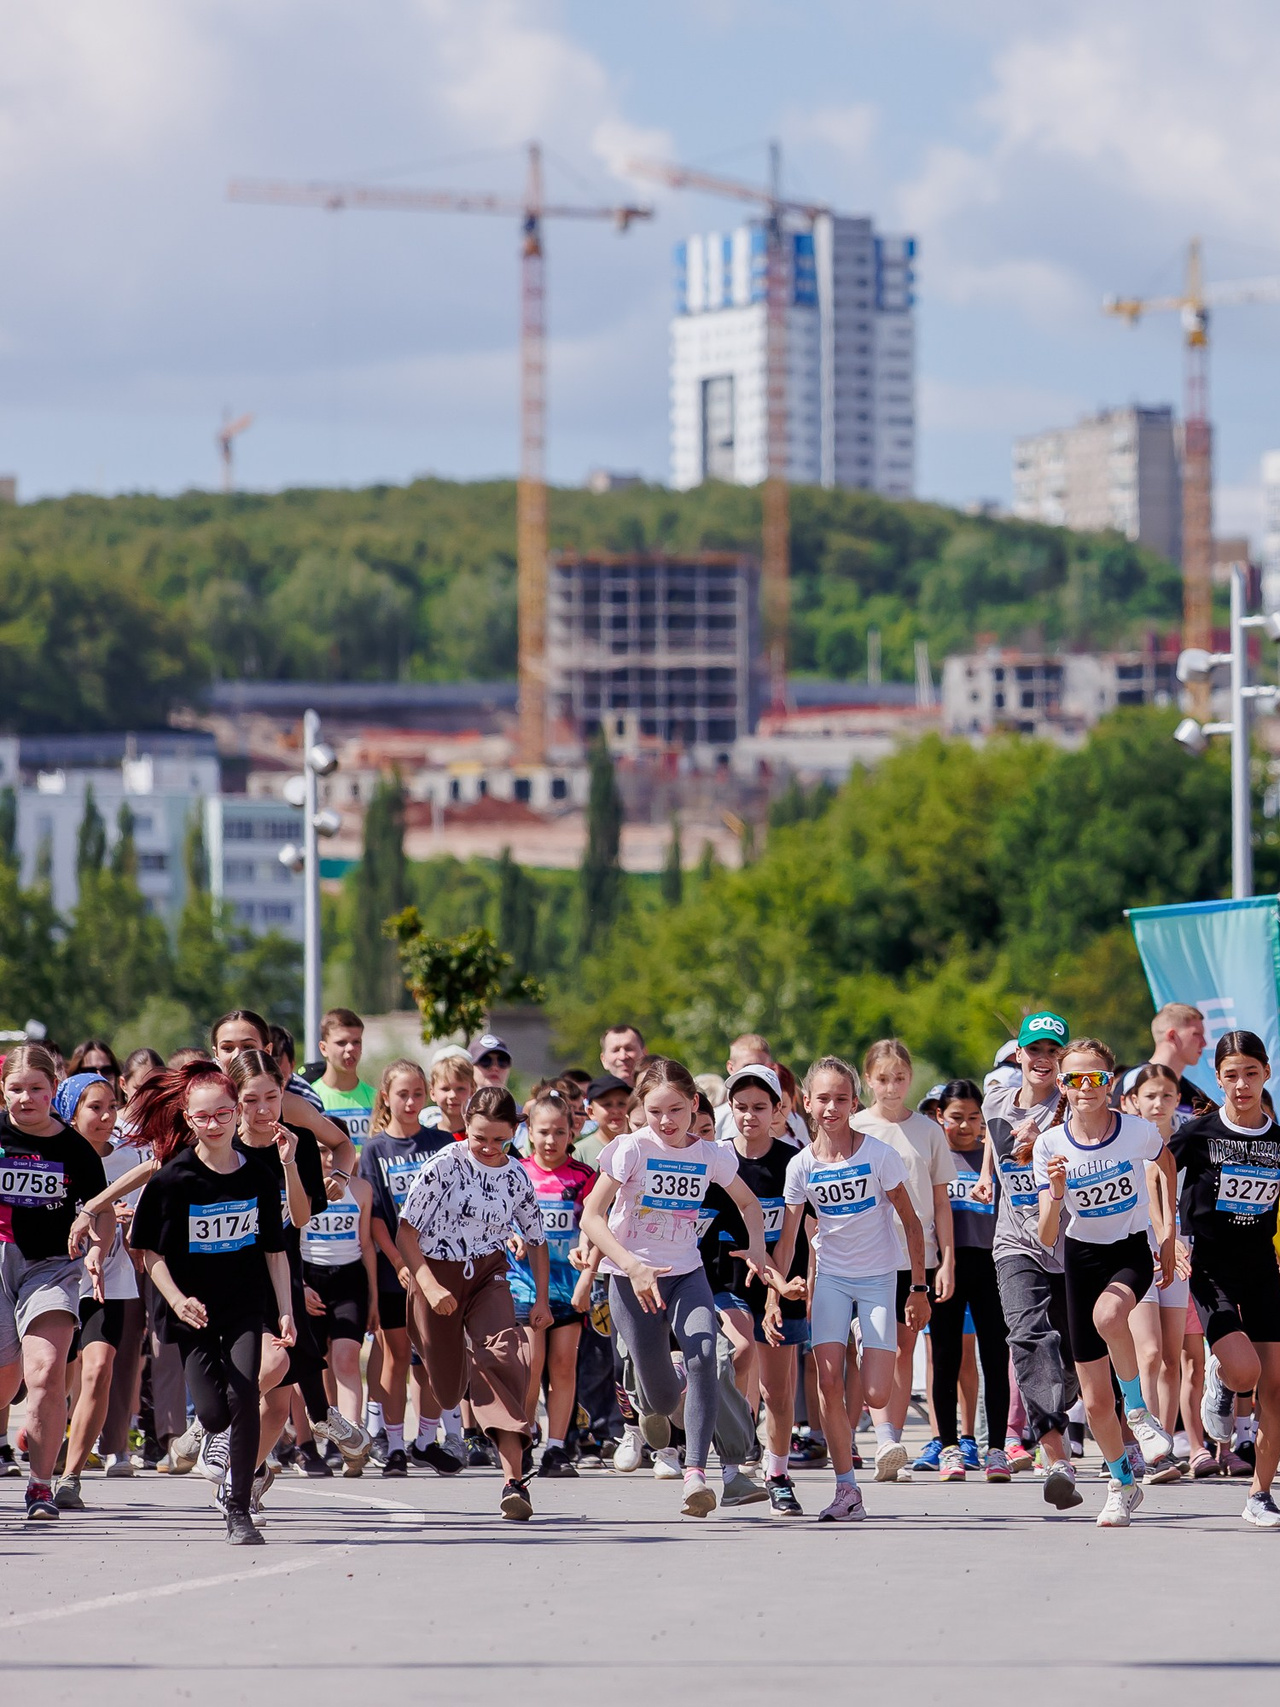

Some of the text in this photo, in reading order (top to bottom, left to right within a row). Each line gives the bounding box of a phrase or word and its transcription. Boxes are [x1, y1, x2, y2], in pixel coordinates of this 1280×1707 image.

[2, 1171, 58, 1195] 0758
[651, 1174, 701, 1198] 3385
[814, 1178, 868, 1204] 3057
[1075, 1176, 1133, 1208] 3228
[1225, 1178, 1279, 1201] 3273
[195, 1213, 251, 1240] 3174
[310, 1215, 355, 1232] 3128
